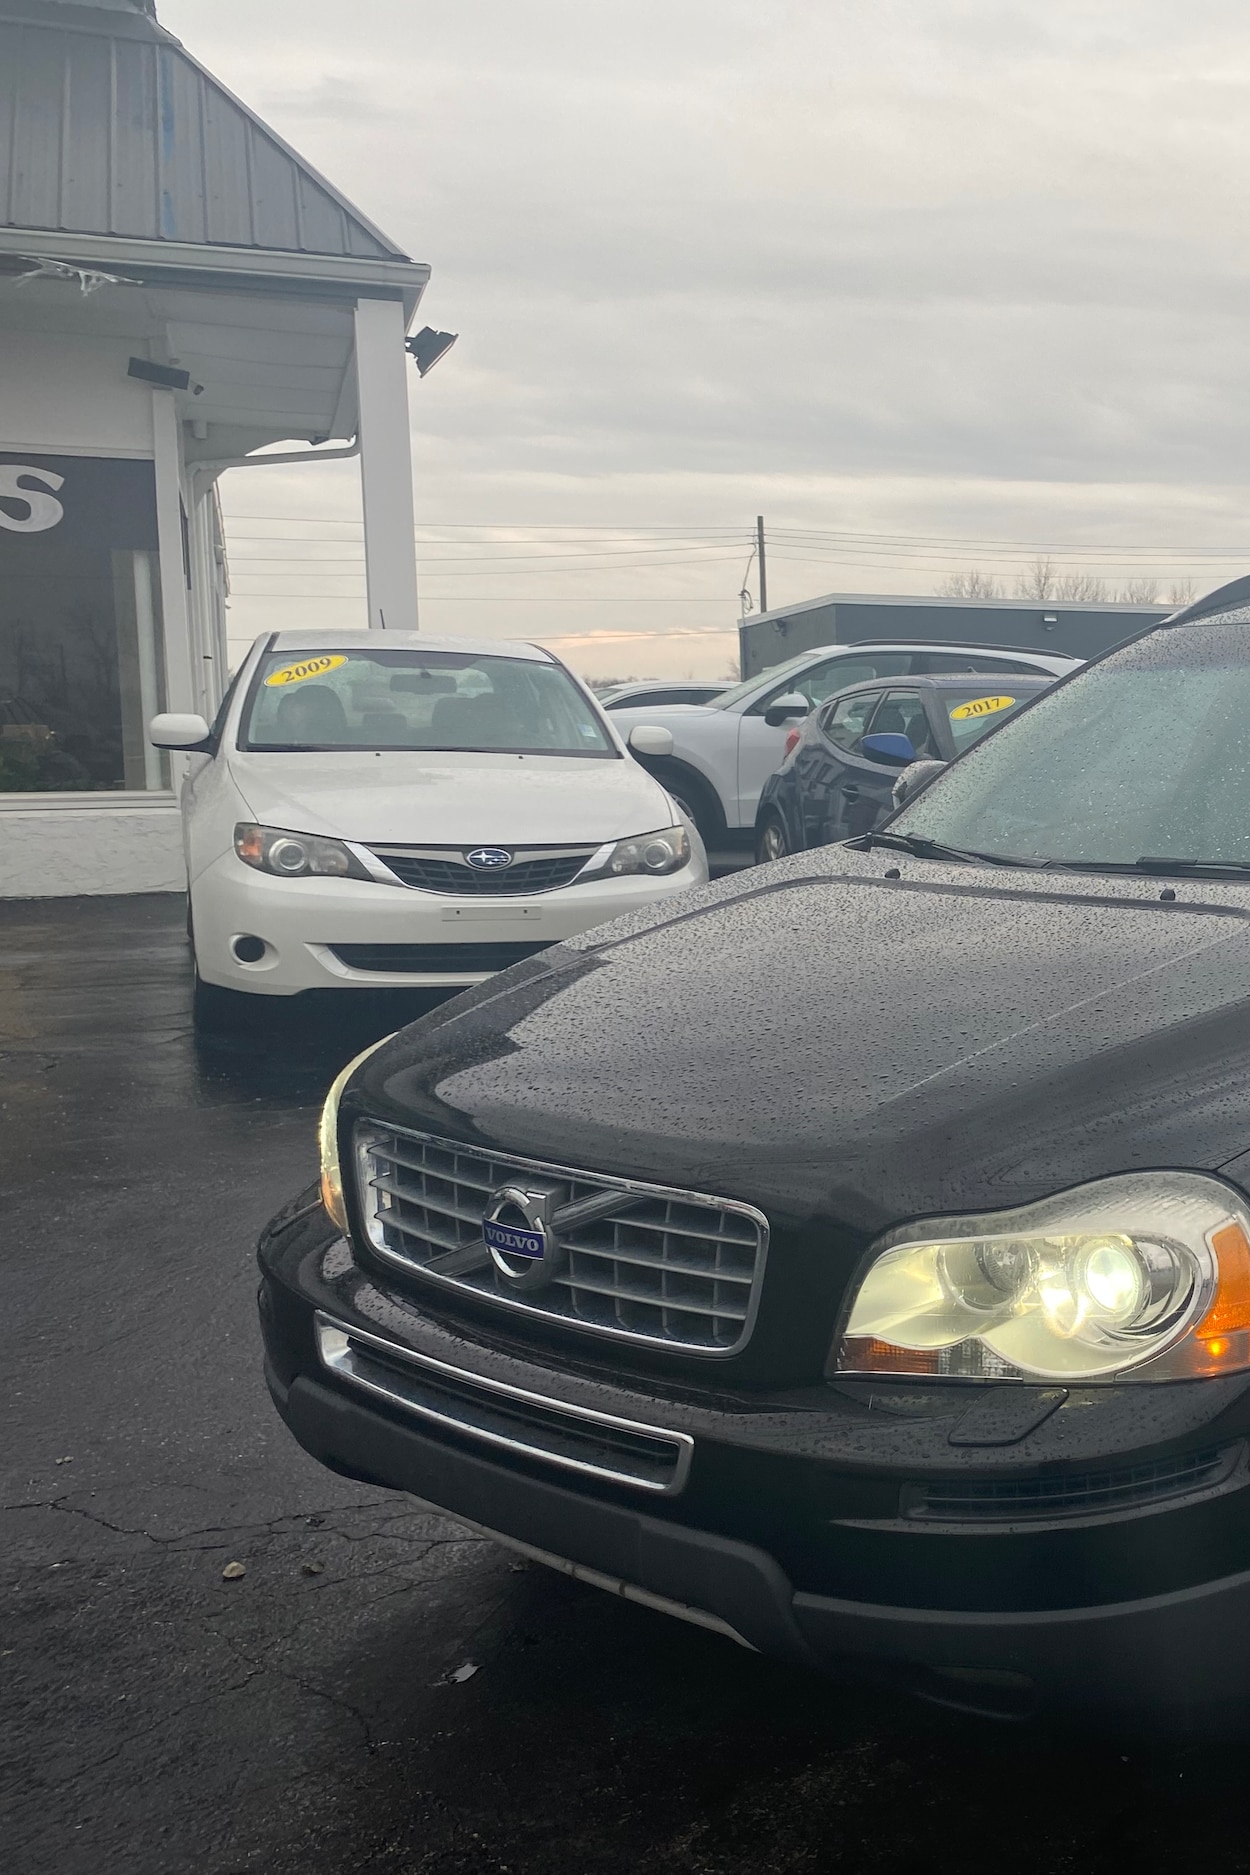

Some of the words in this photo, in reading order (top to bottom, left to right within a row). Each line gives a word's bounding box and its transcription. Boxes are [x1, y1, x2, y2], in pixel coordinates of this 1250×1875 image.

[281, 657, 332, 682] 2009
[962, 697, 1001, 717] 2017
[485, 1226, 540, 1252] VOLVO
